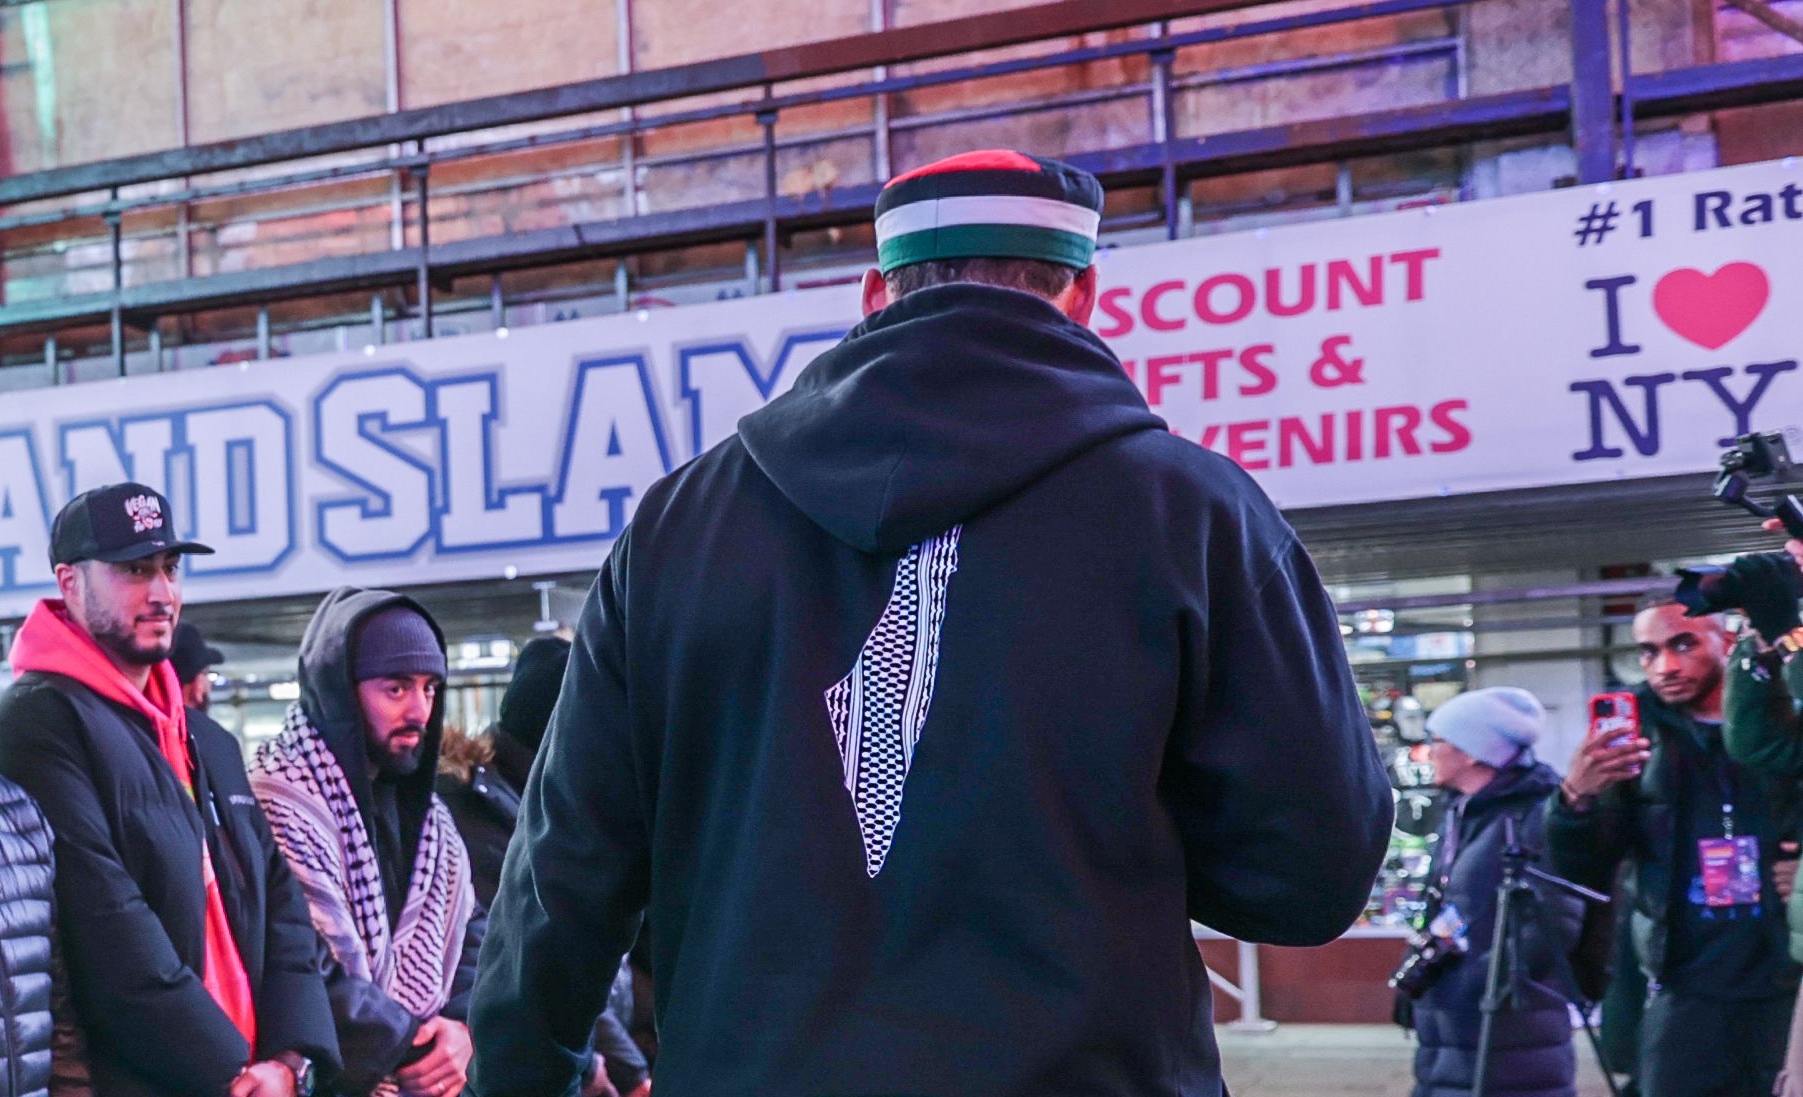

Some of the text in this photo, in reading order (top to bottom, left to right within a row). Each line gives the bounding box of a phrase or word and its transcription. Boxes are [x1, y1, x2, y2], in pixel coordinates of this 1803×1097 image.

[1574, 183, 1803, 246] #1 Rat
[1098, 247, 1442, 338] SCOUNT
[1585, 274, 1641, 358] I
[1309, 334, 1366, 389] &
[1569, 360, 1798, 461] NY
